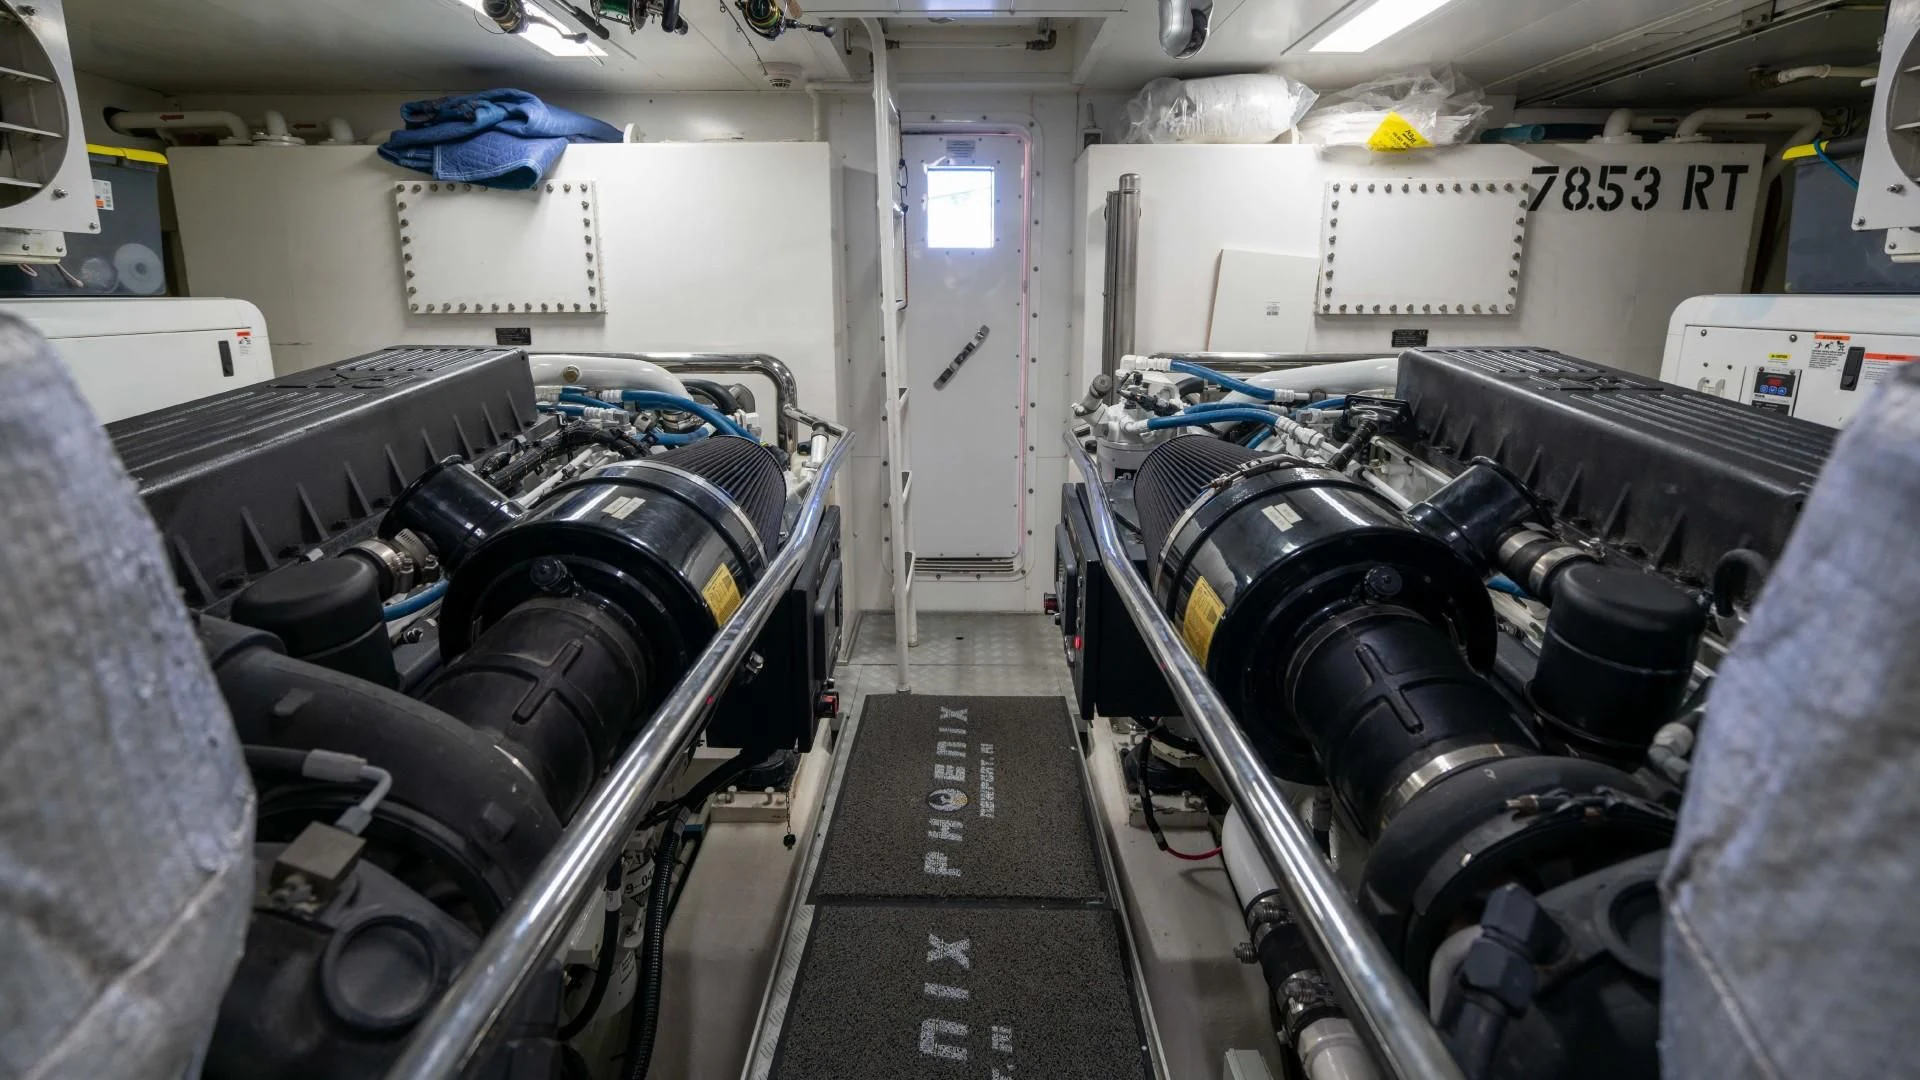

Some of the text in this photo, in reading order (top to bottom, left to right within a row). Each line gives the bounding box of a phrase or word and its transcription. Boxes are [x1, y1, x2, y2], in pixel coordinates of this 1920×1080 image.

[1528, 164, 1749, 212] 78.53 RT
[923, 705, 969, 878] PHOENIX
